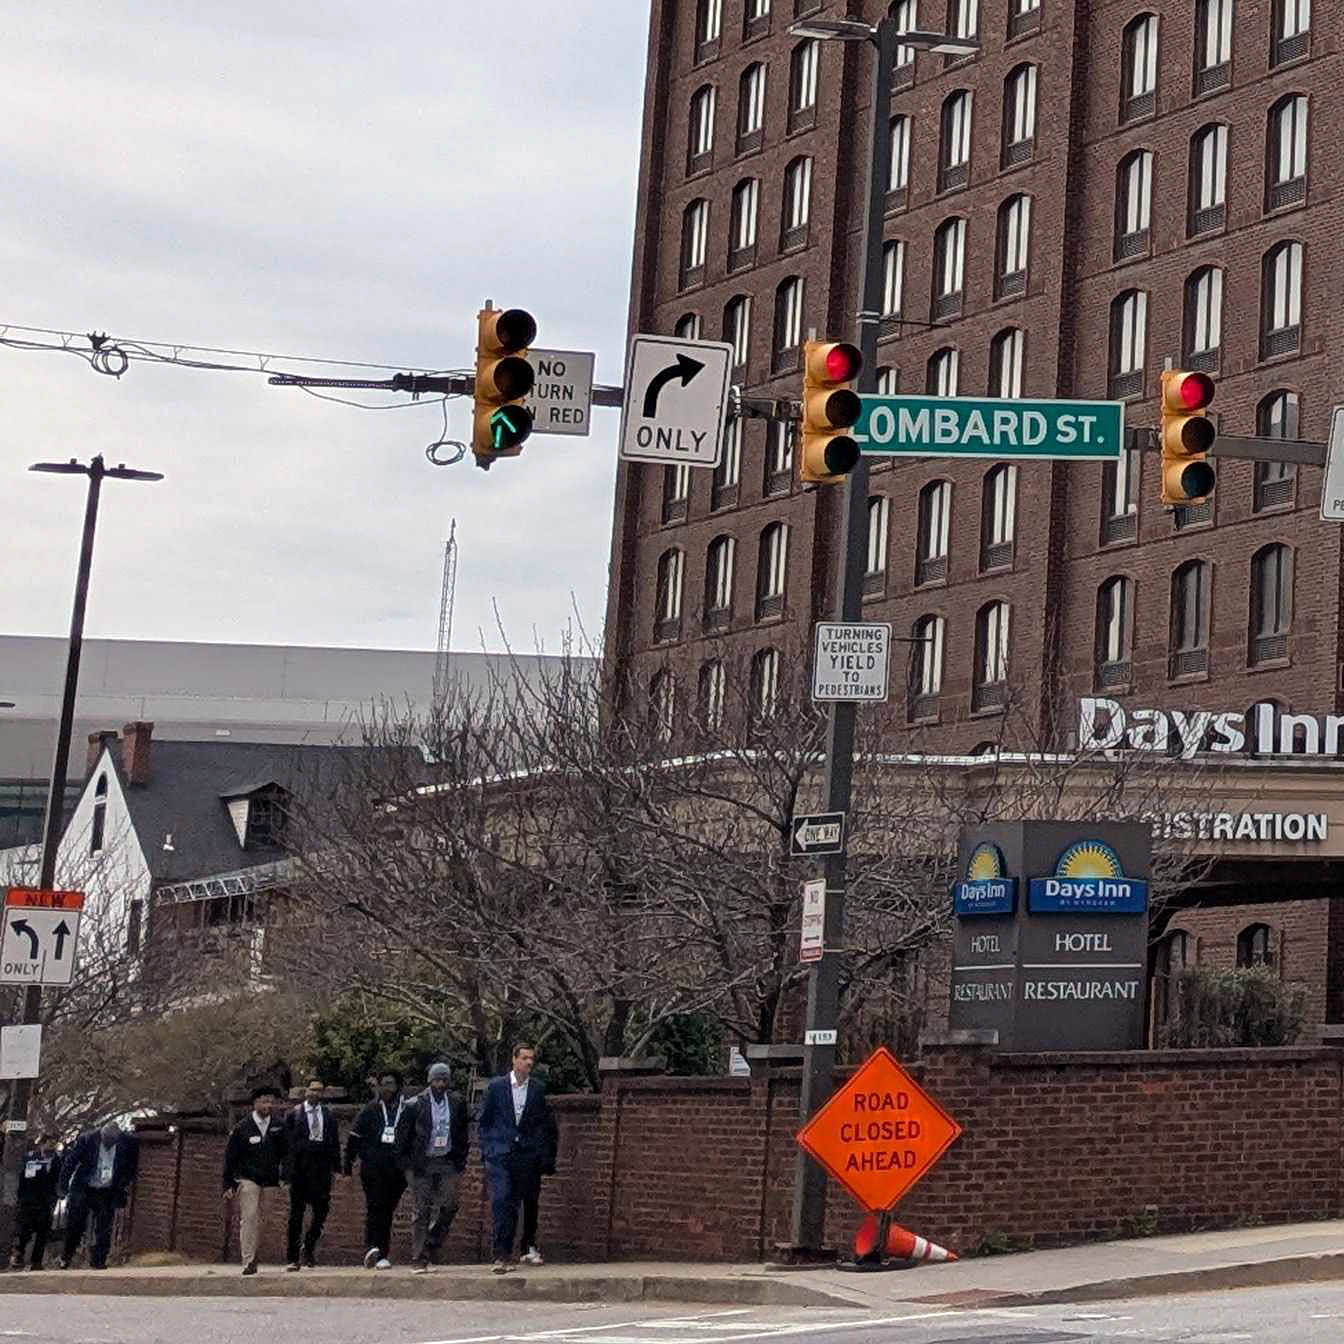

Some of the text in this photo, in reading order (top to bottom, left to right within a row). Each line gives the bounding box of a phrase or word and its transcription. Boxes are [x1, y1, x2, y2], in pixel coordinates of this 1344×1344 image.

[538, 360, 566, 377] NO
[530, 383, 574, 400] TURN
[527, 406, 584, 424] N RED
[1055, 415, 1105, 444] ST.
[637, 426, 708, 453] ONLY
[826, 628, 882, 640] TURNING
[822, 641, 883, 654] VEHICLES
[830, 655, 875, 670] YIELD
[842, 671, 860, 682] TO
[818, 684, 882, 696] PEDESTRIANS
[1077, 698, 1246, 760] Days
[1140, 812, 1328, 842] ISTRATION
[961, 882, 1005, 900] Days Inn
[1046, 879, 1131, 899] Days Inn
[25, 894, 65, 907] NEW
[971, 936, 1001, 953] HOTEL
[1055, 934, 1112, 952] HOTEL
[4, 962, 40, 975] ONLY
[953, 982, 1013, 1001] RESTAURANT
[1023, 981, 1139, 1000] RESTAURANT
[854, 1092, 909, 1112] ROAD
[840, 1121, 920, 1143] CLOSED
[846, 1150, 916, 1172] AHEAD
